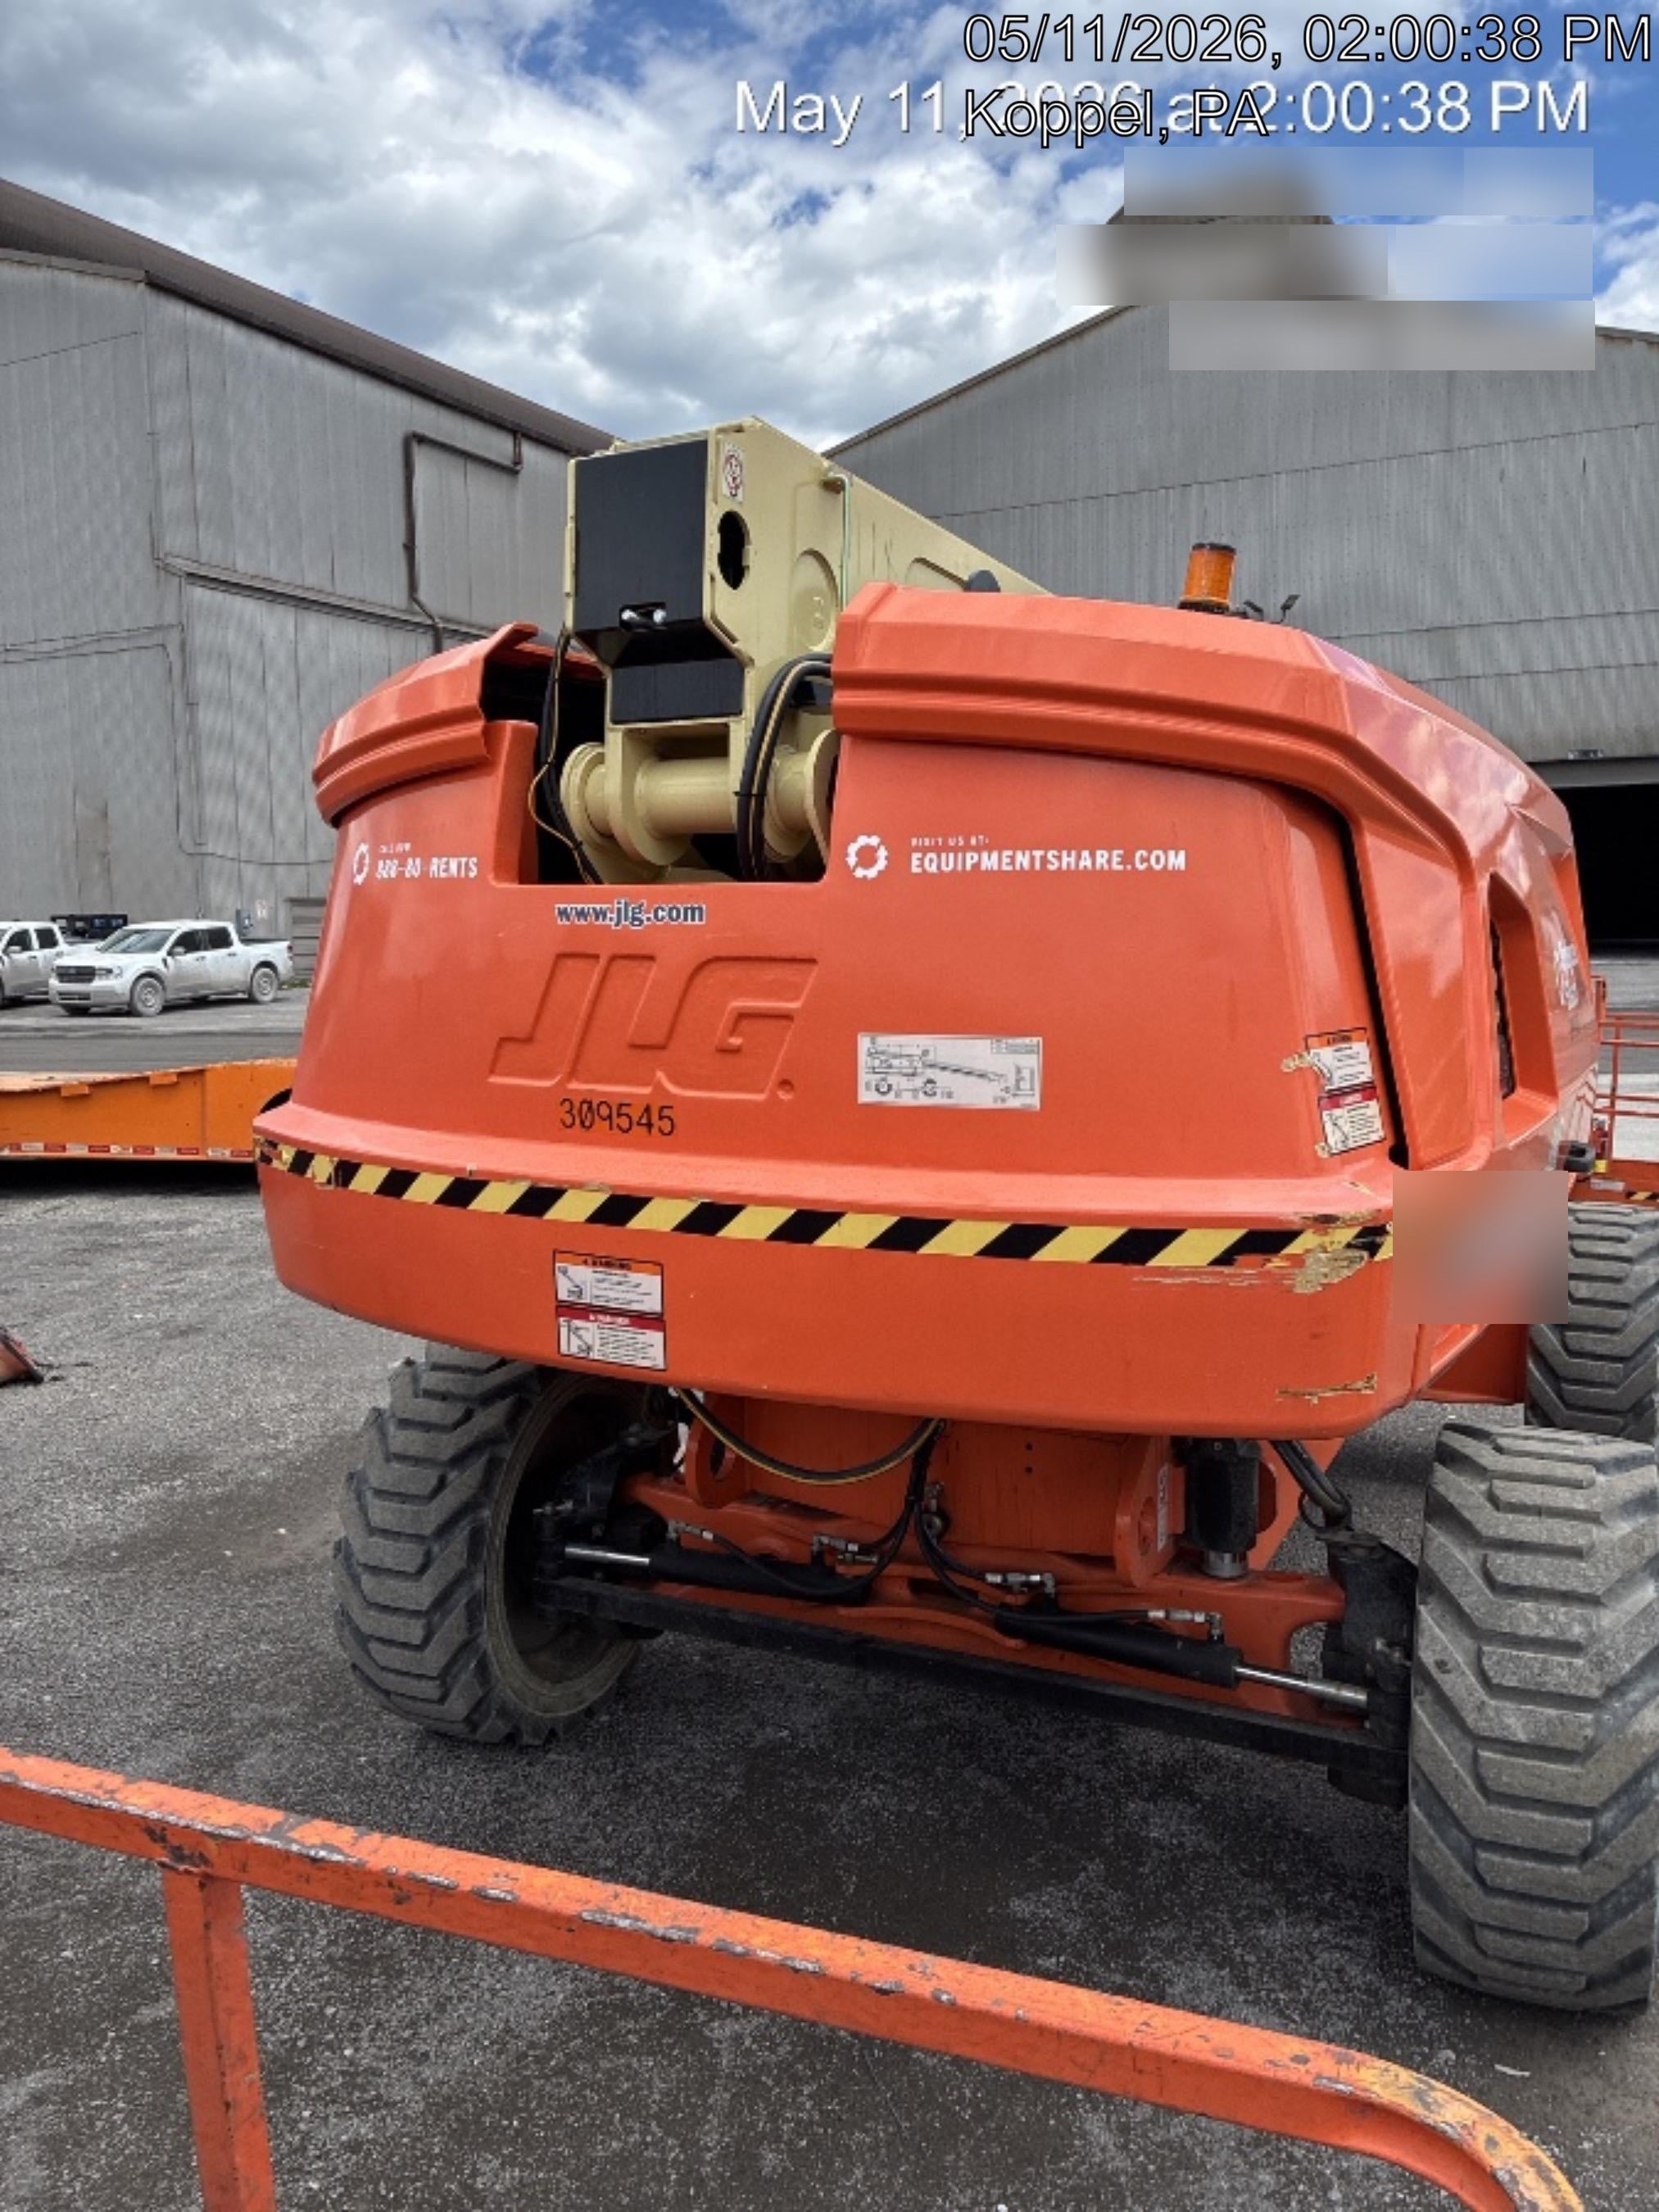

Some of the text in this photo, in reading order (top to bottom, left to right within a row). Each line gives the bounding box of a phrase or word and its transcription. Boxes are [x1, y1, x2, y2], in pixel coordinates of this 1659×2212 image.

[910, 849, 1187, 874] EQUIPMENTSHARE.COM
[555, 900, 706, 930] www.jlg.com
[559, 1097, 677, 1137] 309545
